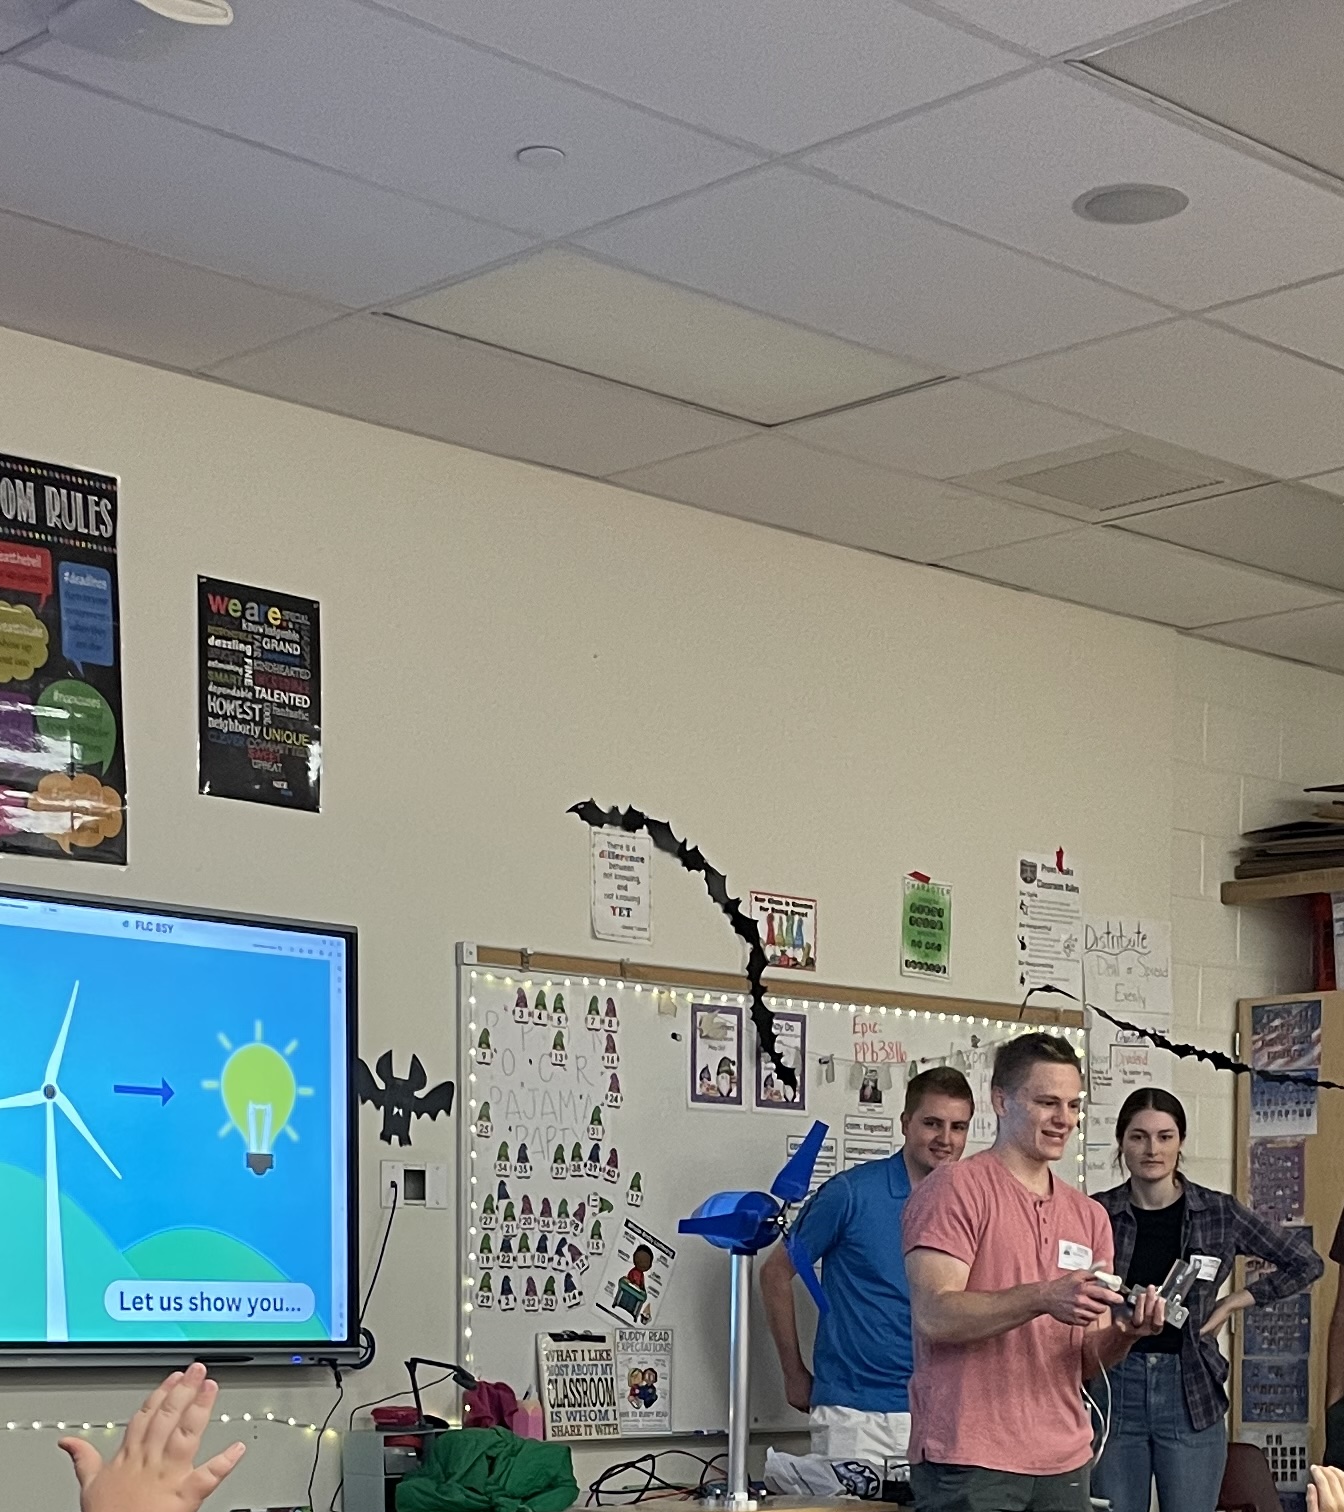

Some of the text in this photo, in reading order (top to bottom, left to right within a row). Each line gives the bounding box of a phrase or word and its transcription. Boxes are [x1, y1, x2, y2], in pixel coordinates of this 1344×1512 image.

[44, 484, 113, 538] RULES
[207, 593, 242, 617] we
[262, 638, 301, 655] GRAND
[254, 686, 311, 708] TALENTED
[207, 694, 262, 721] HONEST
[207, 717, 261, 738] neighborly
[263, 726, 311, 746] UNIQUE
[610, 905, 632, 918] YET
[1084, 920, 1148, 950] Distribute
[591, 1017, 595, 1026] 7
[554, 1053, 564, 1063] 13
[609, 1094, 619, 1104] 24
[480, 1123, 489, 1134] 25
[591, 1127, 599, 1137] 31
[498, 1163, 508, 1173] 34
[555, 1167, 565, 1177] 37
[588, 1162, 598, 1173] 39
[631, 1193, 640, 1203] 17
[483, 1216, 493, 1225] 27
[522, 1217, 532, 1226] 20
[558, 1220, 567, 1229] 23
[505, 1224, 514, 1234] 21
[591, 1241, 600, 1250] 15
[501, 1255, 511, 1264] 22
[576, 1259, 586, 1271] 12
[119, 1290, 302, 1318] Let us show you...
[567, 1293, 577, 1303] 14
[619, 1330, 670, 1342] BUDDY READ
[617, 1341, 672, 1353] EXPECTATIONS
[545, 1348, 613, 1362] WHAT I LIKE
[546, 1363, 613, 1377] MOST ABOUT MY
[547, 1376, 617, 1409] CLASSROOM
[550, 1409, 618, 1423] IS WHOM I
[551, 1423, 620, 1438] SHARE IT WITH
